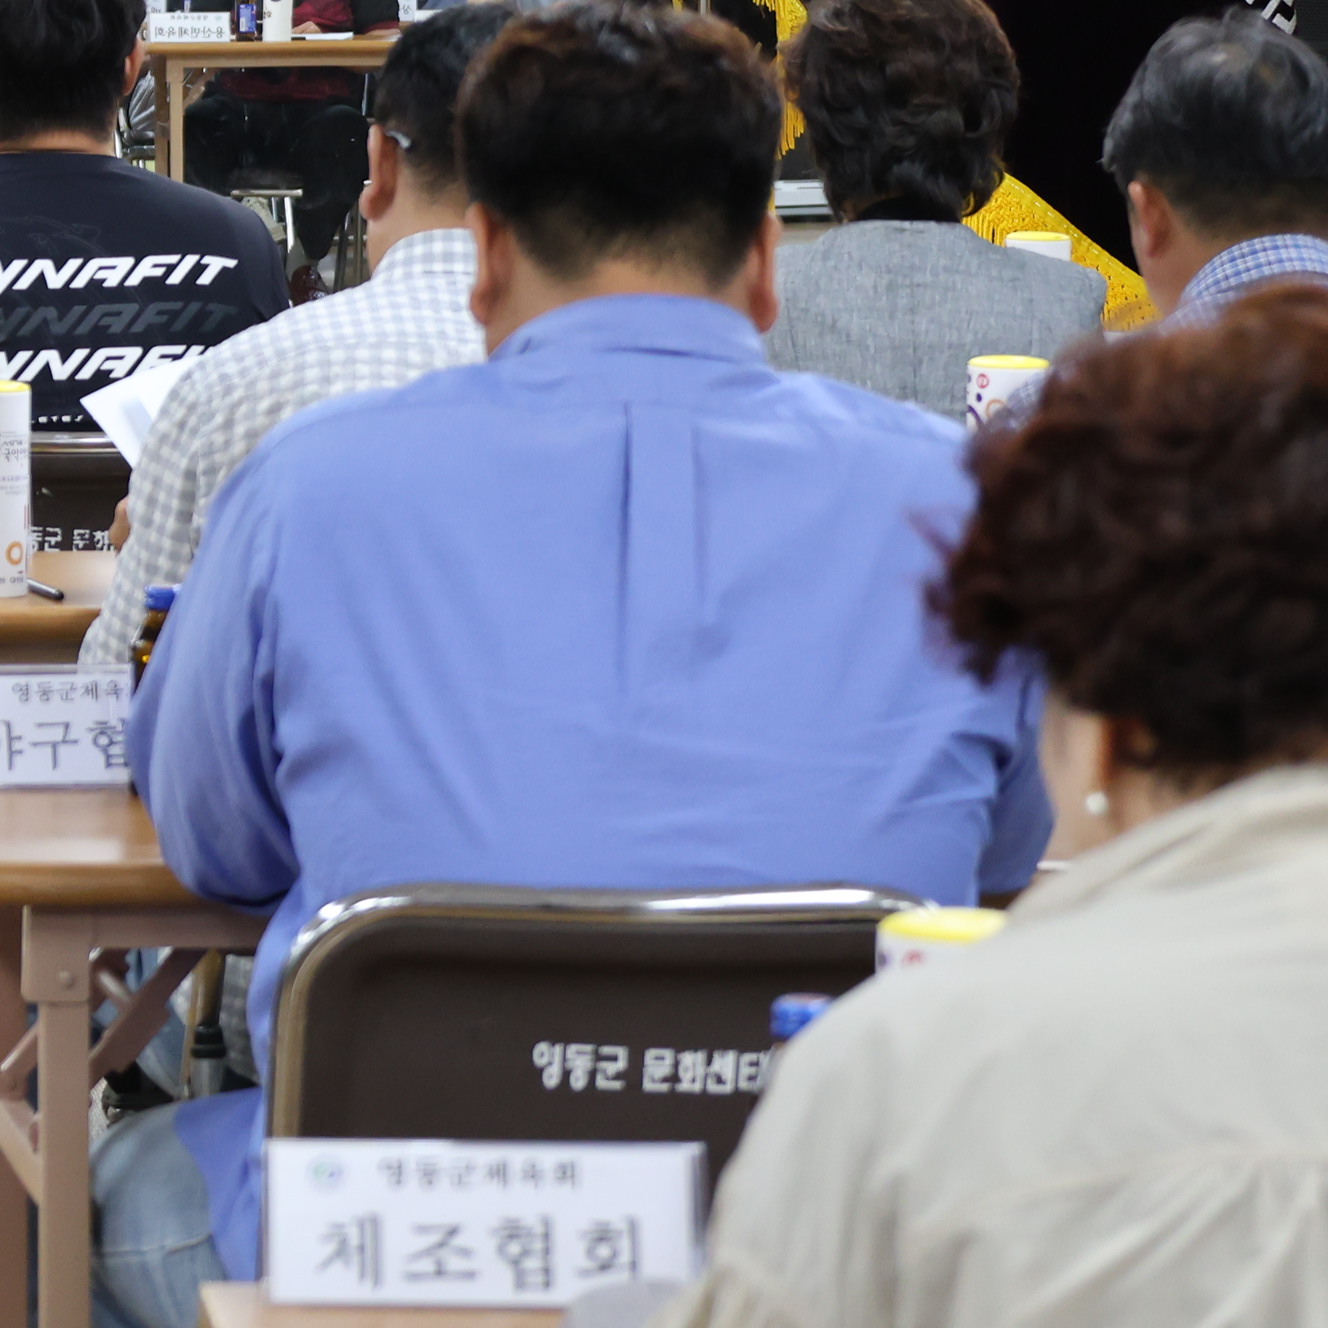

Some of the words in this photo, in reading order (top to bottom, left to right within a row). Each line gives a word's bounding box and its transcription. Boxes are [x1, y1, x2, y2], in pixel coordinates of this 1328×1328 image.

[11, 679, 129, 704] 영동군체육
[533, 1040, 629, 1091] 영동군
[314, 1212, 641, 1295] 체조협회
